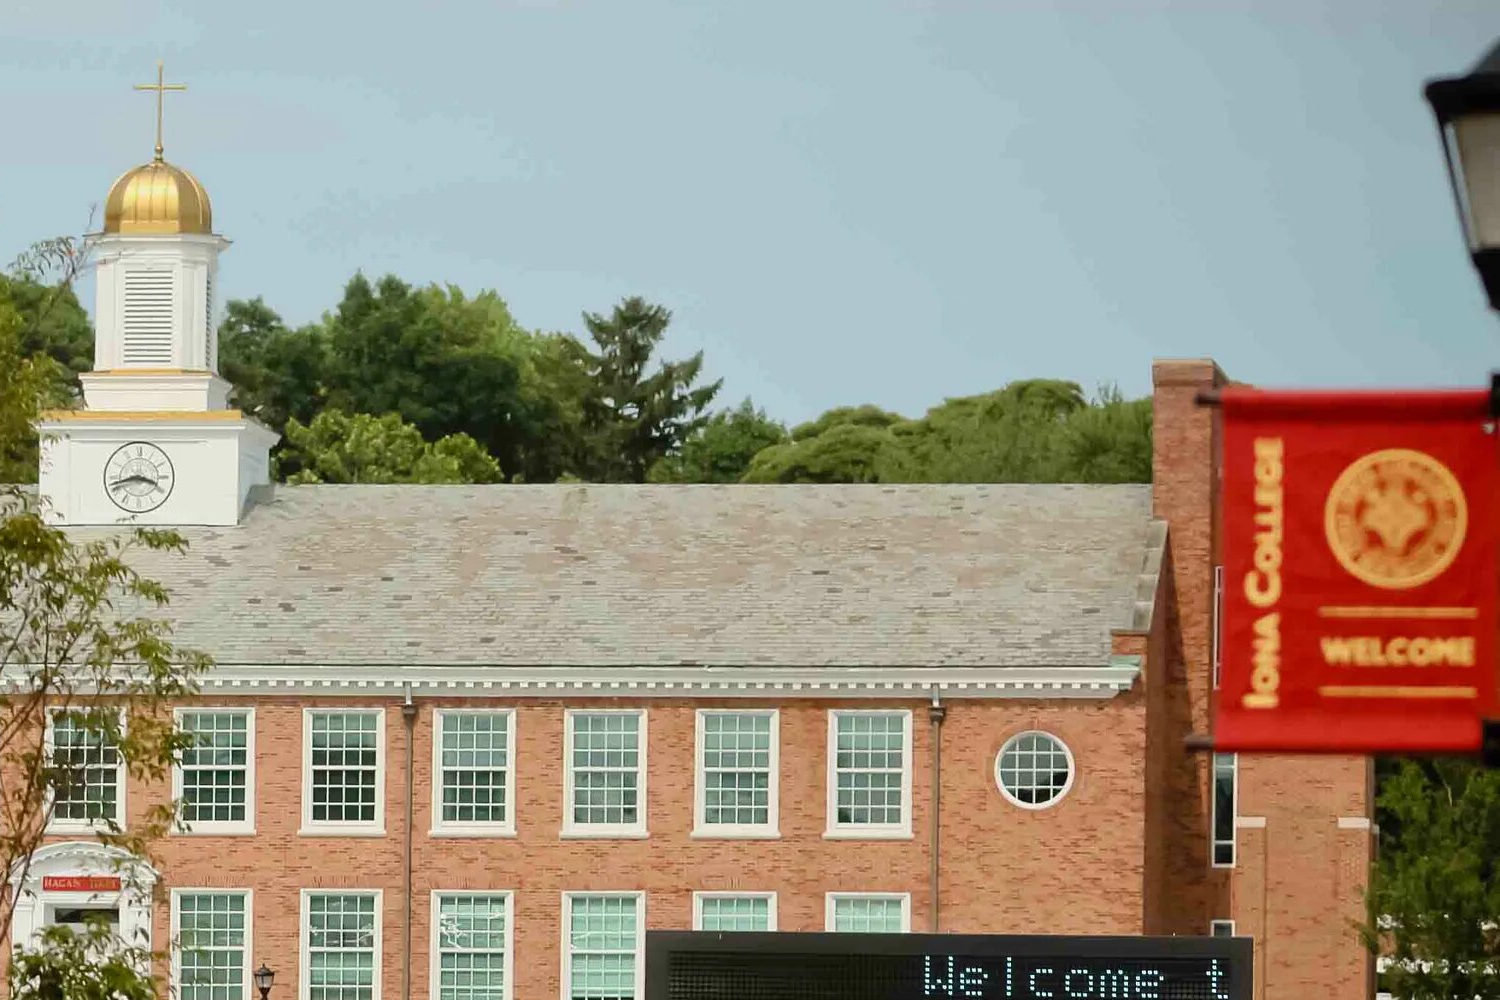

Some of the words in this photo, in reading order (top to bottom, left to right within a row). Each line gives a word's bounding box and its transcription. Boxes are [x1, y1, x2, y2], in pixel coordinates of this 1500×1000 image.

[1244, 436, 1284, 607] COLLEGE
[1242, 612, 1280, 709] IONA
[1319, 636, 1475, 667] WELCOME
[924, 955, 1165, 998] Welcome
